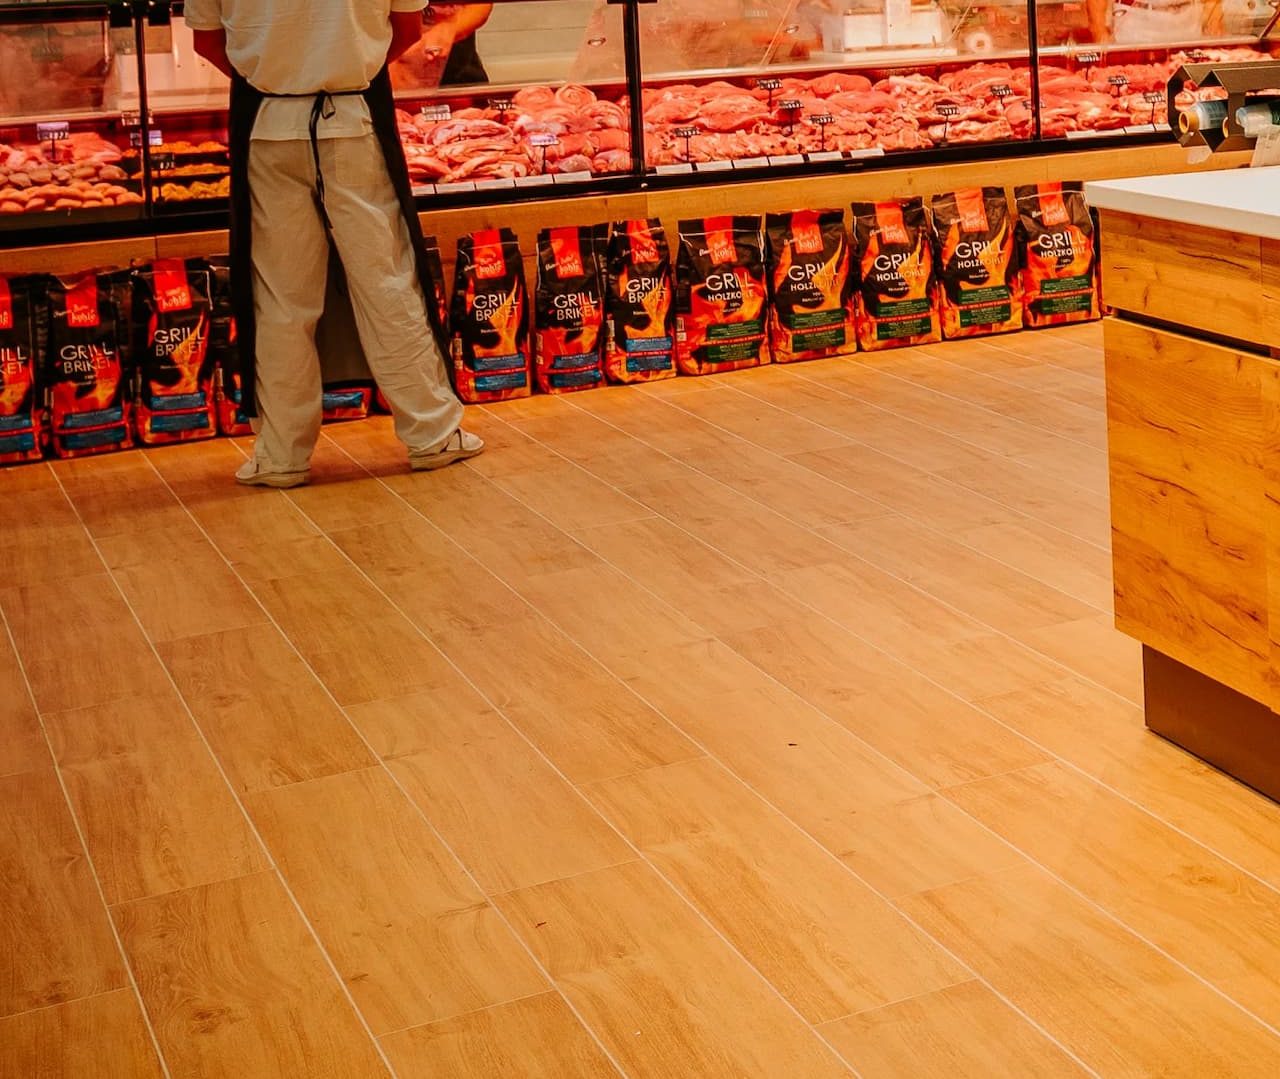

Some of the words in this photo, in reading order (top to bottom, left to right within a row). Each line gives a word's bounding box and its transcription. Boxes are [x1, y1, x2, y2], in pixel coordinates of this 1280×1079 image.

[955, 240, 1005, 258] GRILL
[1038, 230, 1086, 249] GRILL
[788, 261, 839, 281] GRILL
[874, 252, 924, 271] GRILL
[626, 277, 668, 292] GRILL
[705, 272, 755, 291] GRILL
[472, 292, 520, 310] GRILL
[554, 291, 598, 310] GRILL
[557, 304, 597, 320] BRIKET
[154, 327, 206, 344] GRILL
[60, 341, 114, 361] GRILL
[63, 355, 113, 375] BRIKET
